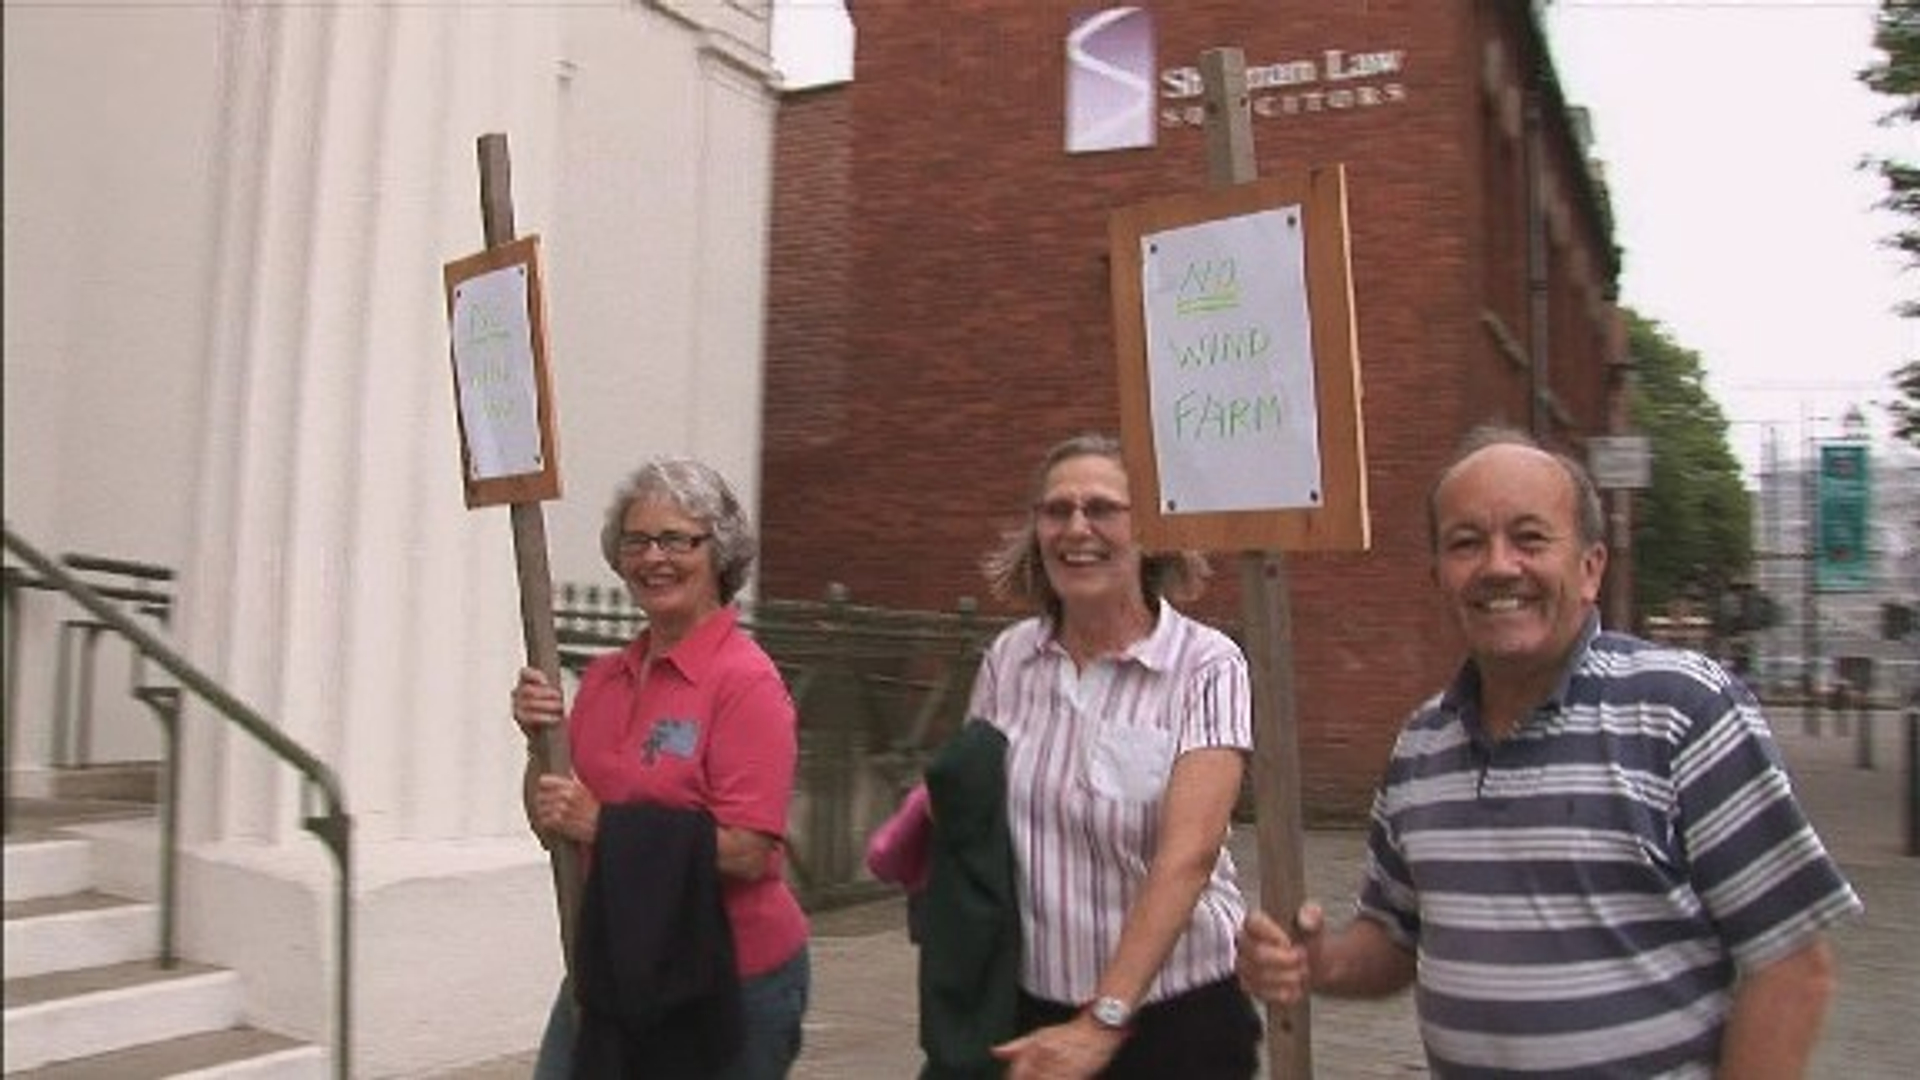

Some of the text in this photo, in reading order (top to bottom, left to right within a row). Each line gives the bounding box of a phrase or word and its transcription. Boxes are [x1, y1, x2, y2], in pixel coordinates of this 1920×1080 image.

[1160, 49, 1402, 99] Shman Law
[1161, 83, 1404, 128] SOCITORS
[1179, 257, 1238, 296] NO
[1168, 326, 1272, 369] WIND
[1174, 388, 1283, 440] FARM
